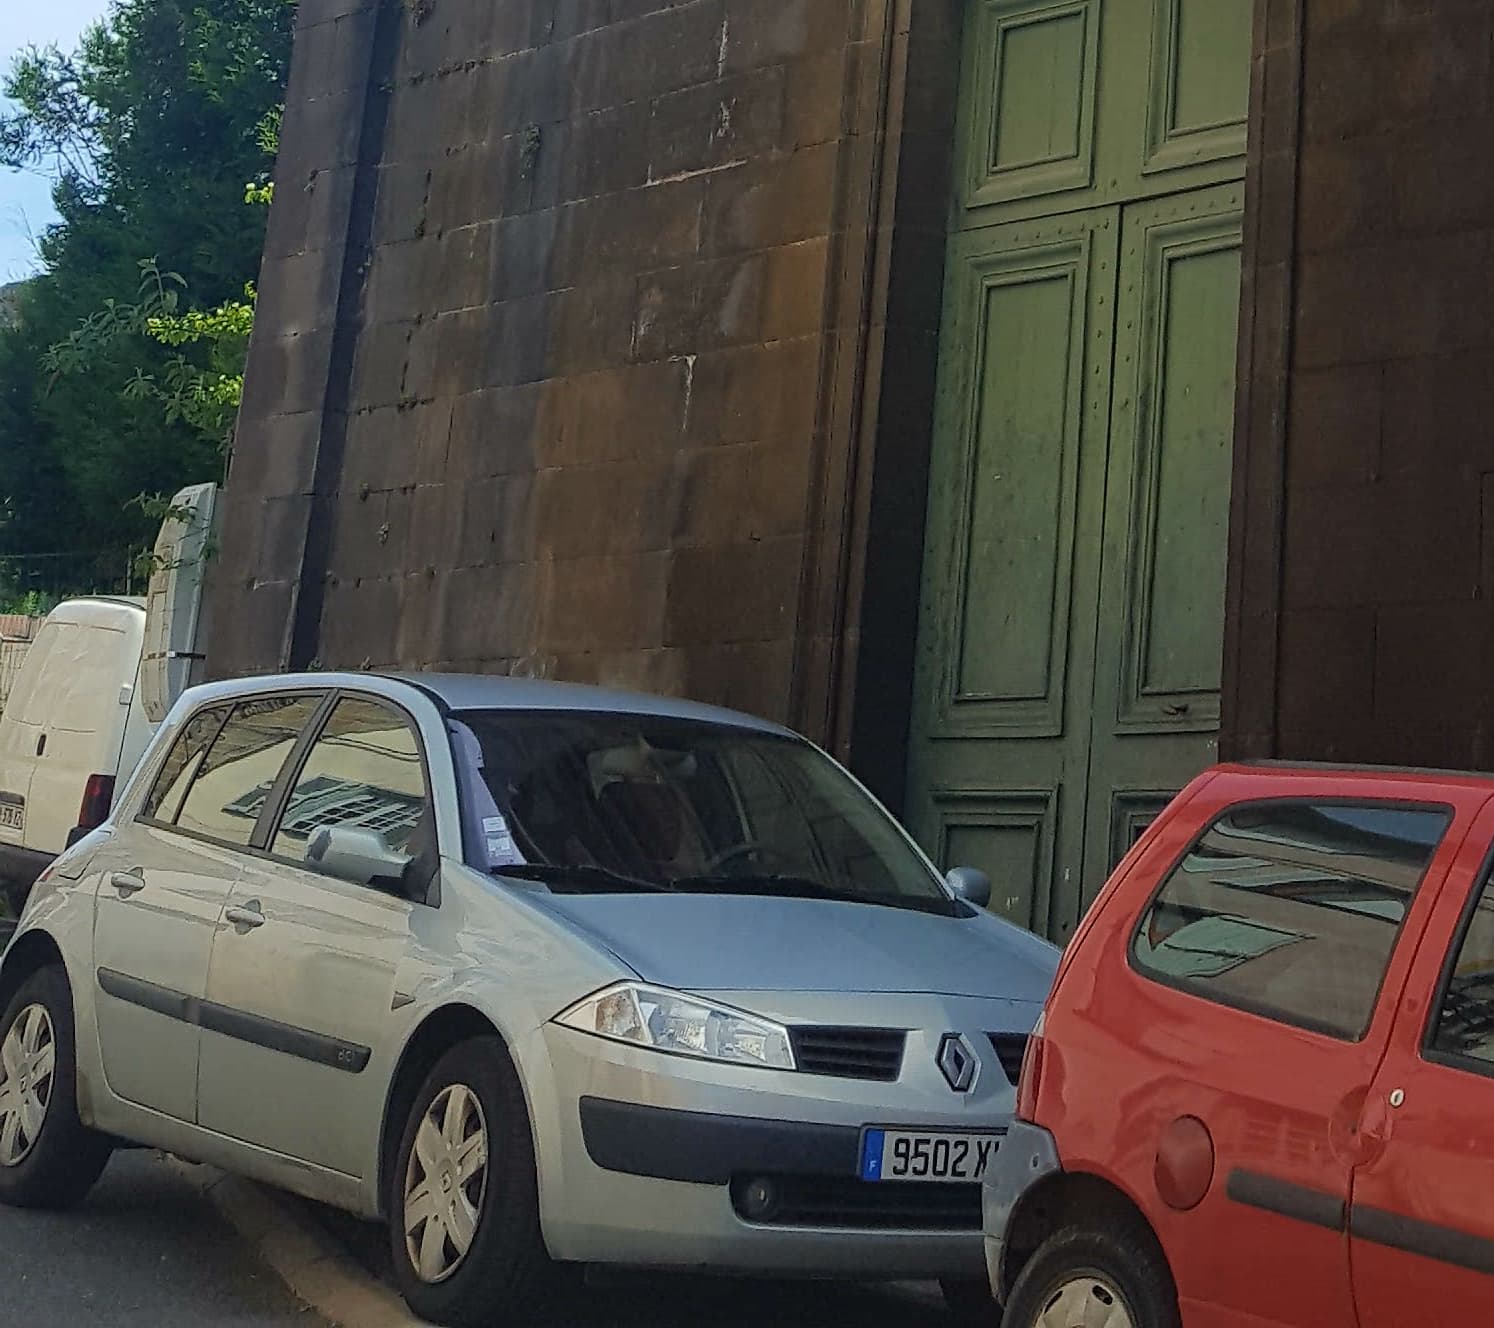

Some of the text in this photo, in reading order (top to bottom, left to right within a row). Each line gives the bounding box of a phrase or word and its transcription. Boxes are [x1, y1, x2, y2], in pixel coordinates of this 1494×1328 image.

[868, 1160, 877, 1173] F
[892, 1138, 1000, 1178] 9502 X
